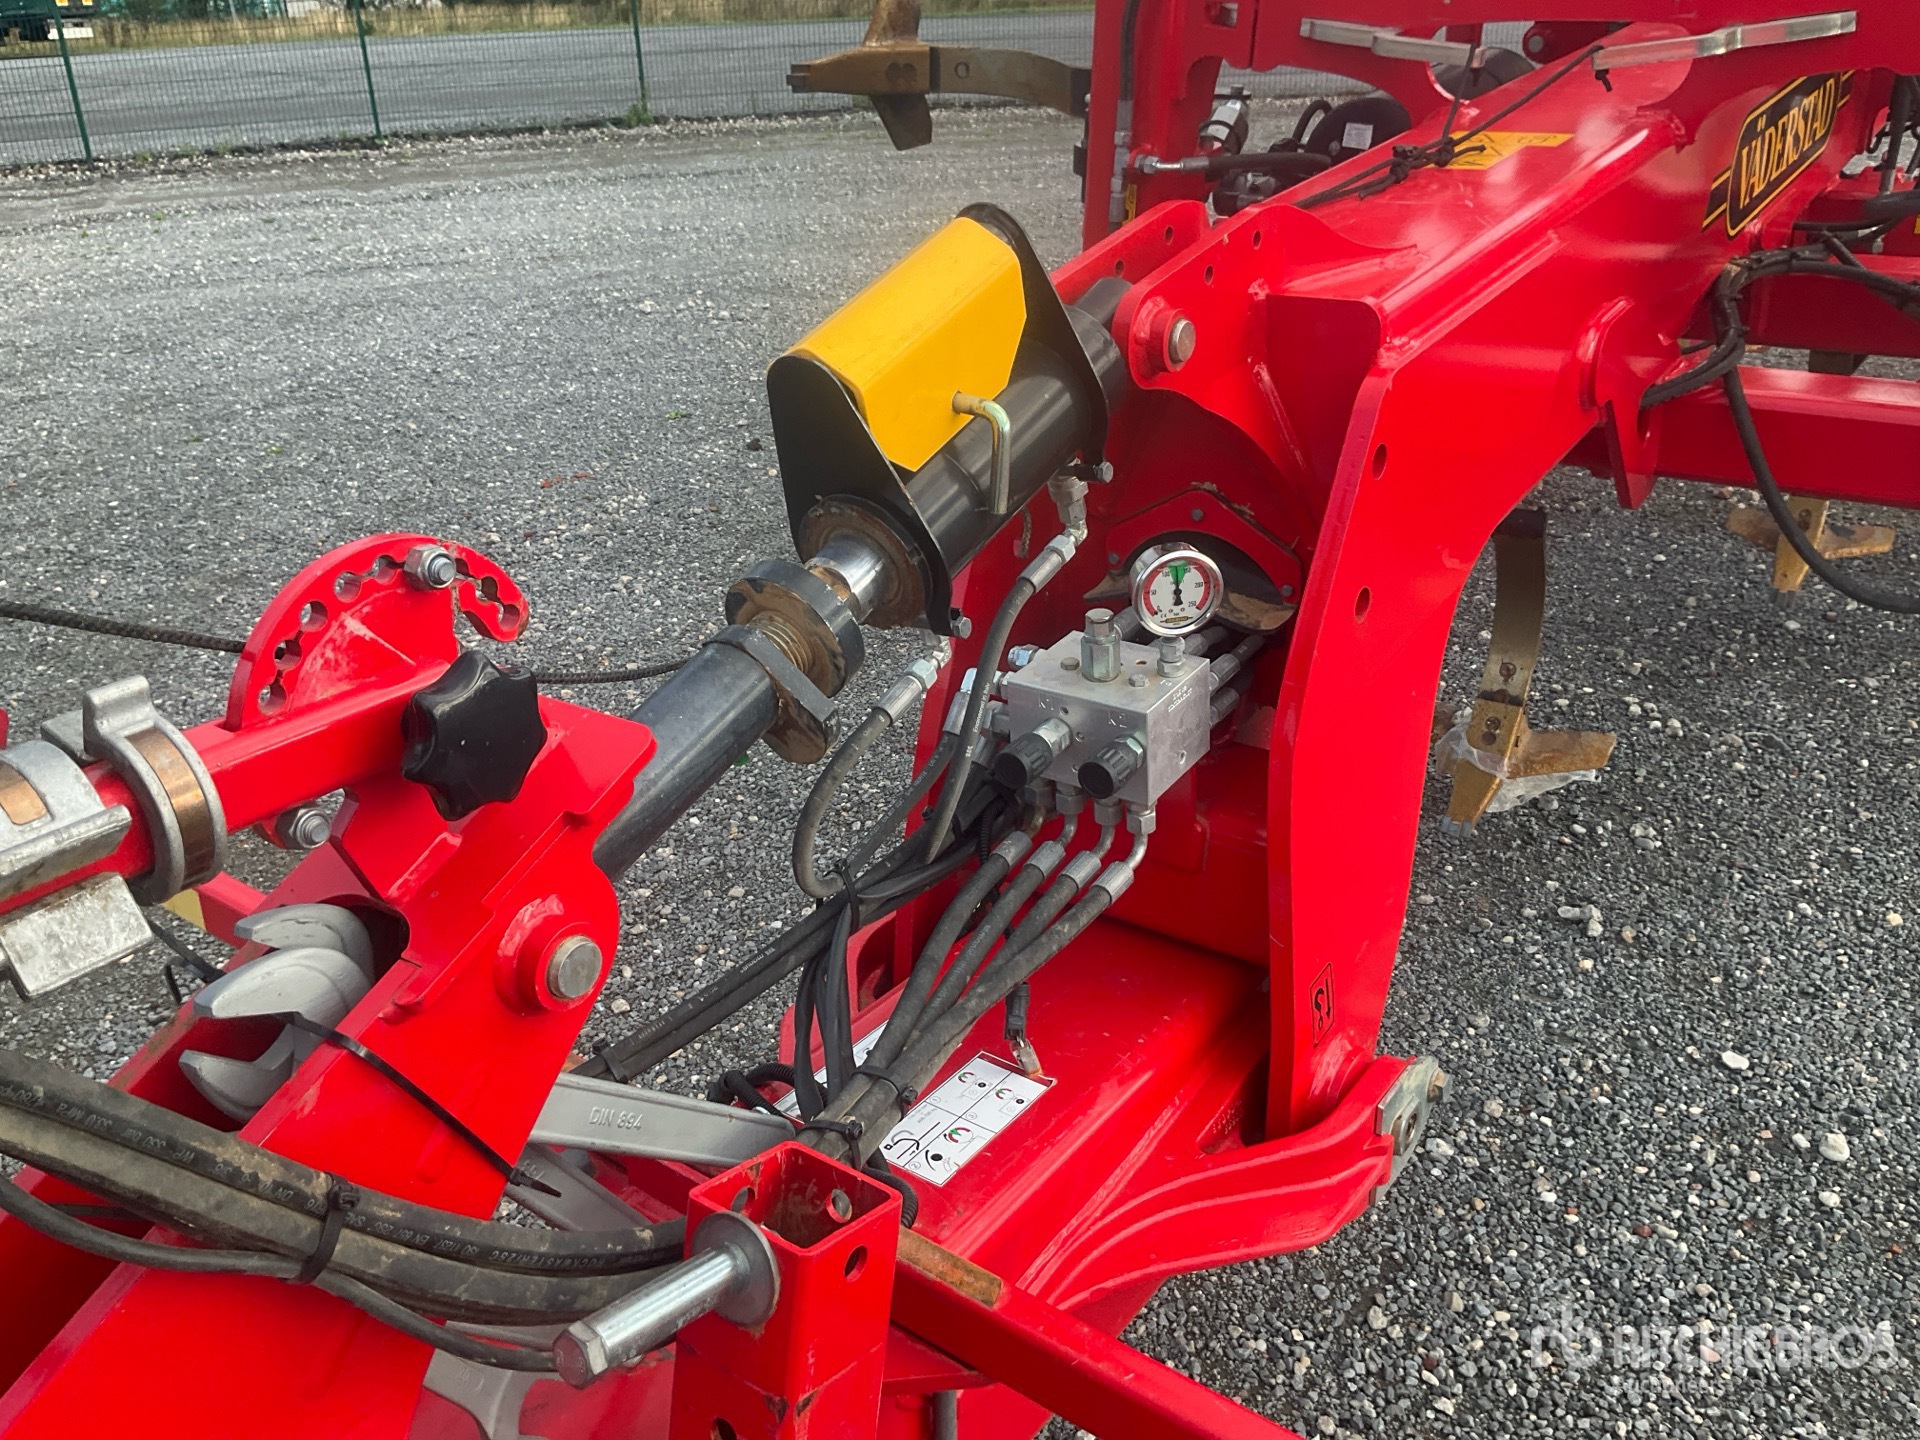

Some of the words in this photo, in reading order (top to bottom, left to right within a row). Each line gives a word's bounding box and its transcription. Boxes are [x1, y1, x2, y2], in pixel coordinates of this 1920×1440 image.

[1740, 78, 1835, 209] VÄDERSTAD
[56, 1102, 85, 1122] MPa
[589, 1106, 615, 1126] DIN
[616, 1110, 644, 1131] 894
[121, 1127, 142, 1143] bar
[140, 1135, 167, 1152] 330
[172, 1147, 196, 1163] WP
[274, 1187, 294, 1201] DN
[343, 1212, 366, 1226] SAE
[413, 1232, 430, 1243] EN
[461, 1244, 480, 1257] ISO
